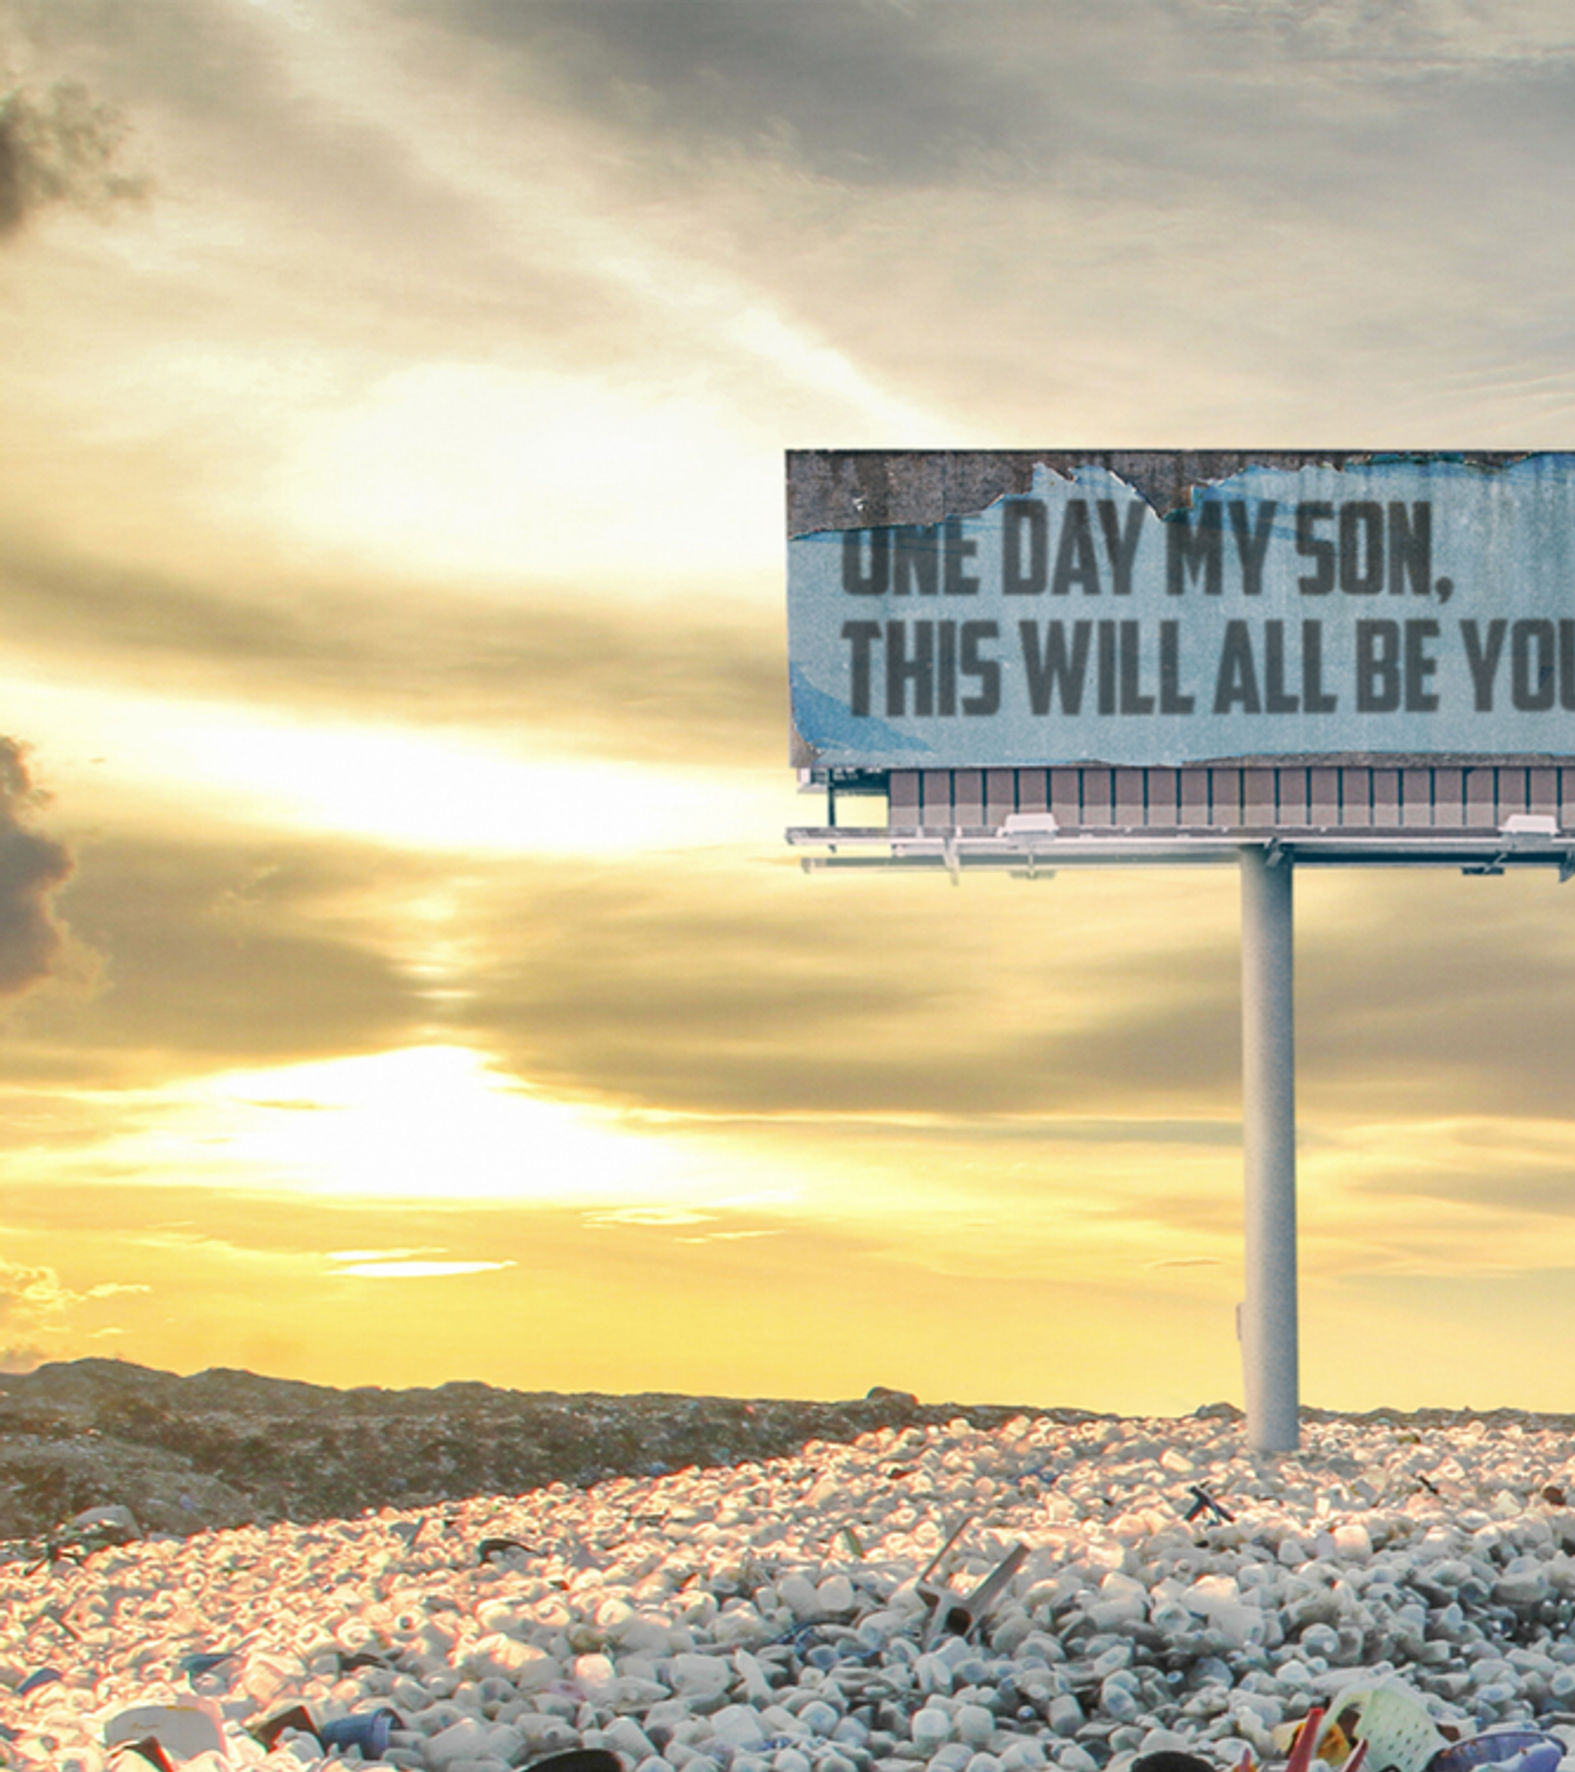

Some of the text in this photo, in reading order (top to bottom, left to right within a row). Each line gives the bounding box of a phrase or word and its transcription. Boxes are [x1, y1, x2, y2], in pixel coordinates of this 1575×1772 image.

[841, 497, 1455, 605] ONE DAY MY SON,
[840, 618, 1002, 718] THIS
[1018, 618, 1196, 717] WILL
[1212, 617, 1339, 715] ALL
[1355, 617, 1442, 714] BE
